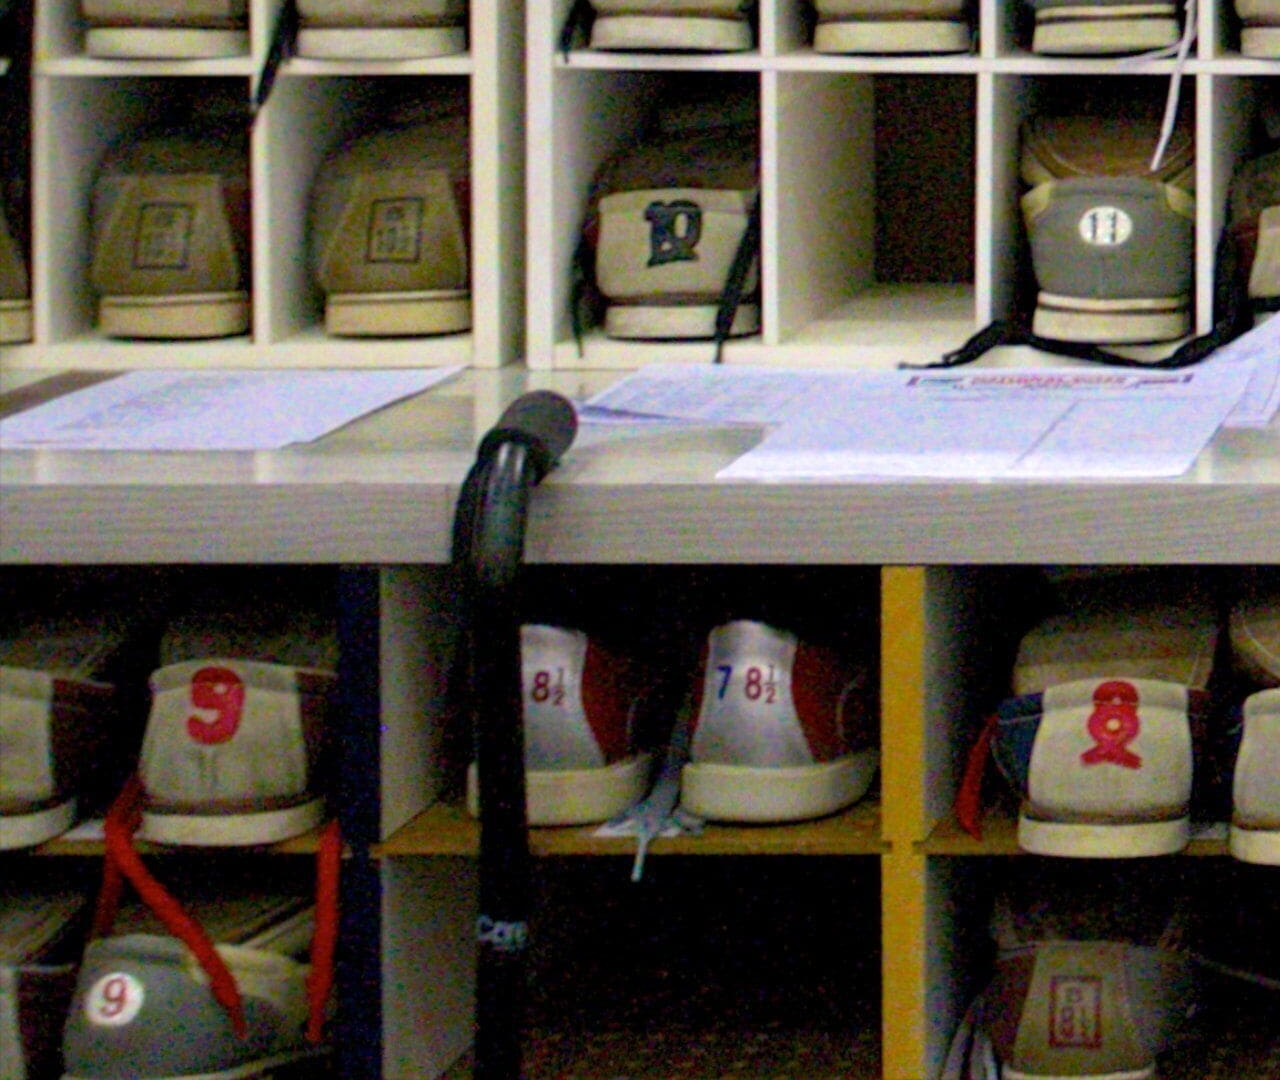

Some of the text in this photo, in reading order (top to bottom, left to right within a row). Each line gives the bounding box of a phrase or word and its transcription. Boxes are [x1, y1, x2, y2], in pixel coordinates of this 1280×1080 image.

[187, 666, 244, 745] 9
[717, 665, 732, 700] 7
[1081, 681, 1140, 769] 8
[100, 978, 126, 1017] 9
